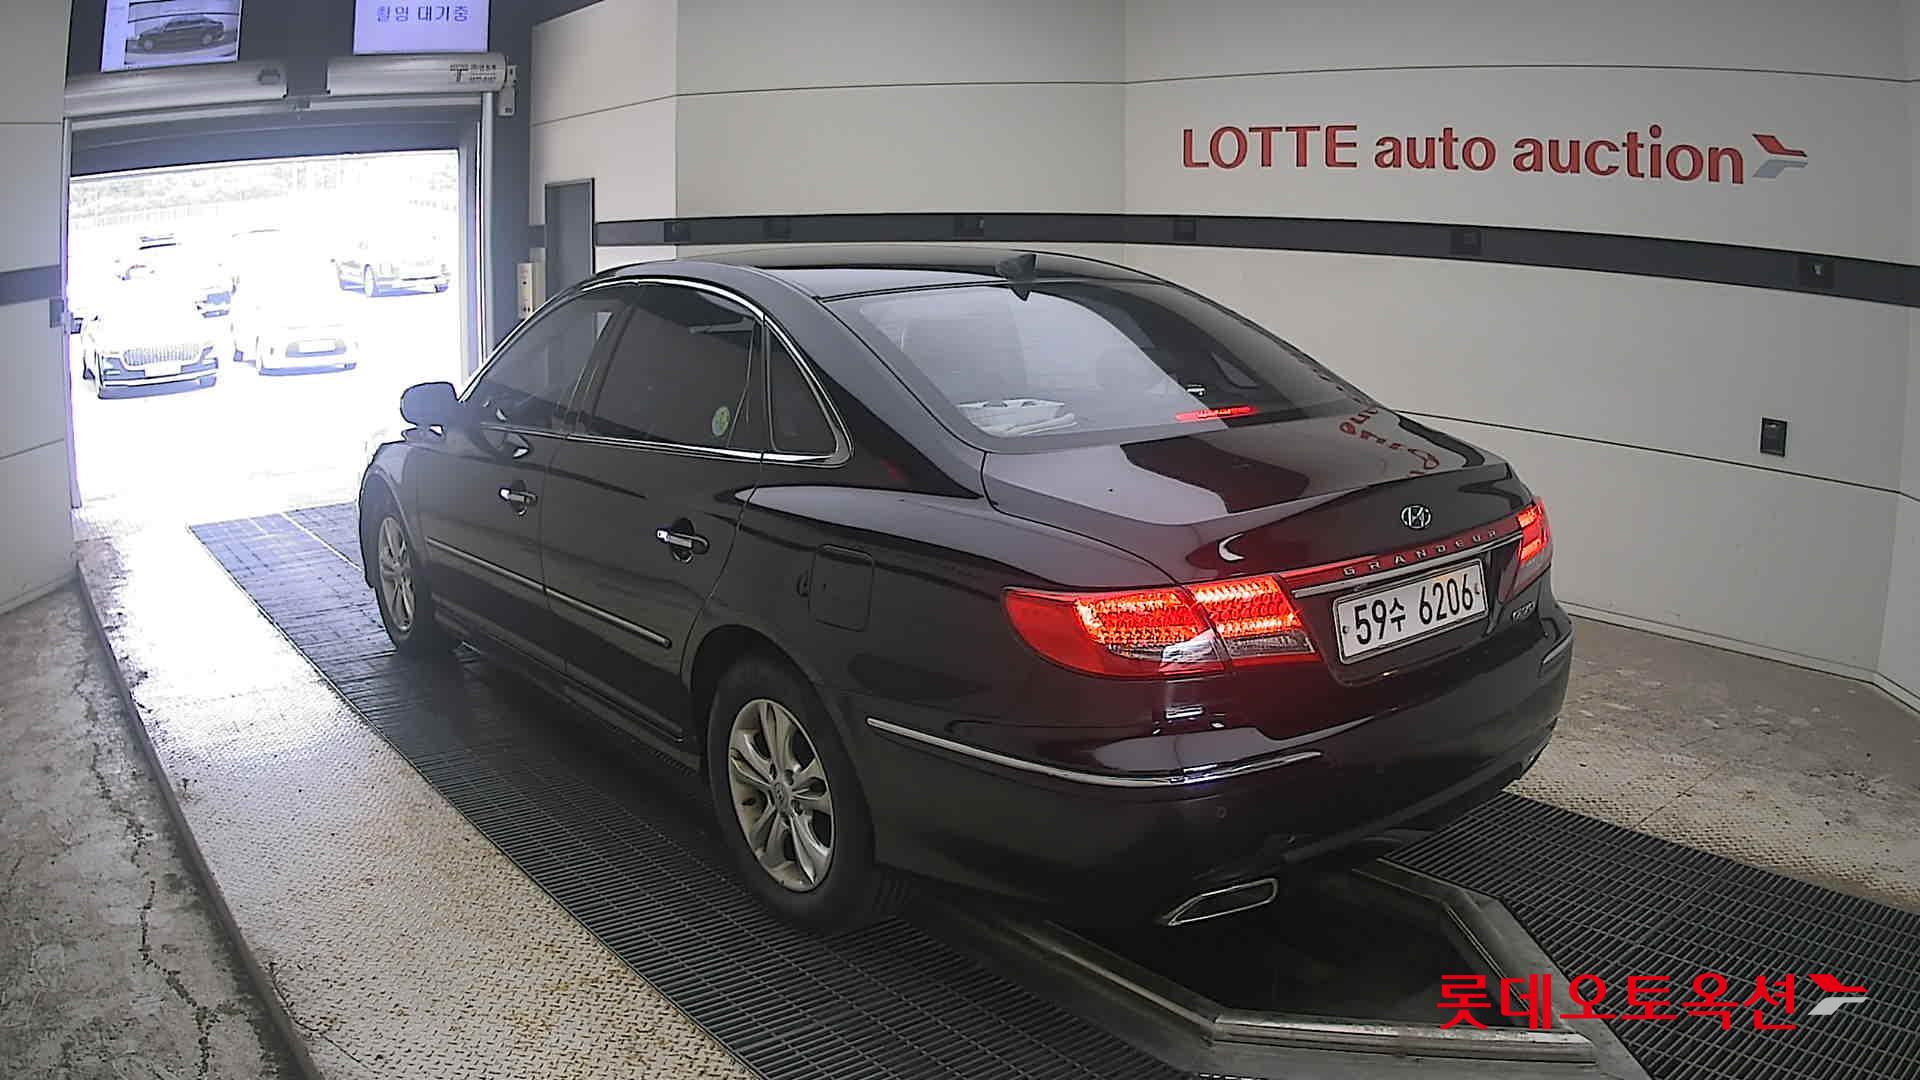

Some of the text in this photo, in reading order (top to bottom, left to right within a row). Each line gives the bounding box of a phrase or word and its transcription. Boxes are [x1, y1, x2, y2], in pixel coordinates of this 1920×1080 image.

[417, 5, 468, 22] 대기중
[1183, 124, 1744, 185] LOTTE auto auction
[1343, 528, 1497, 577] GRANDEUR
[1354, 573, 1475, 645] 59수 6206
